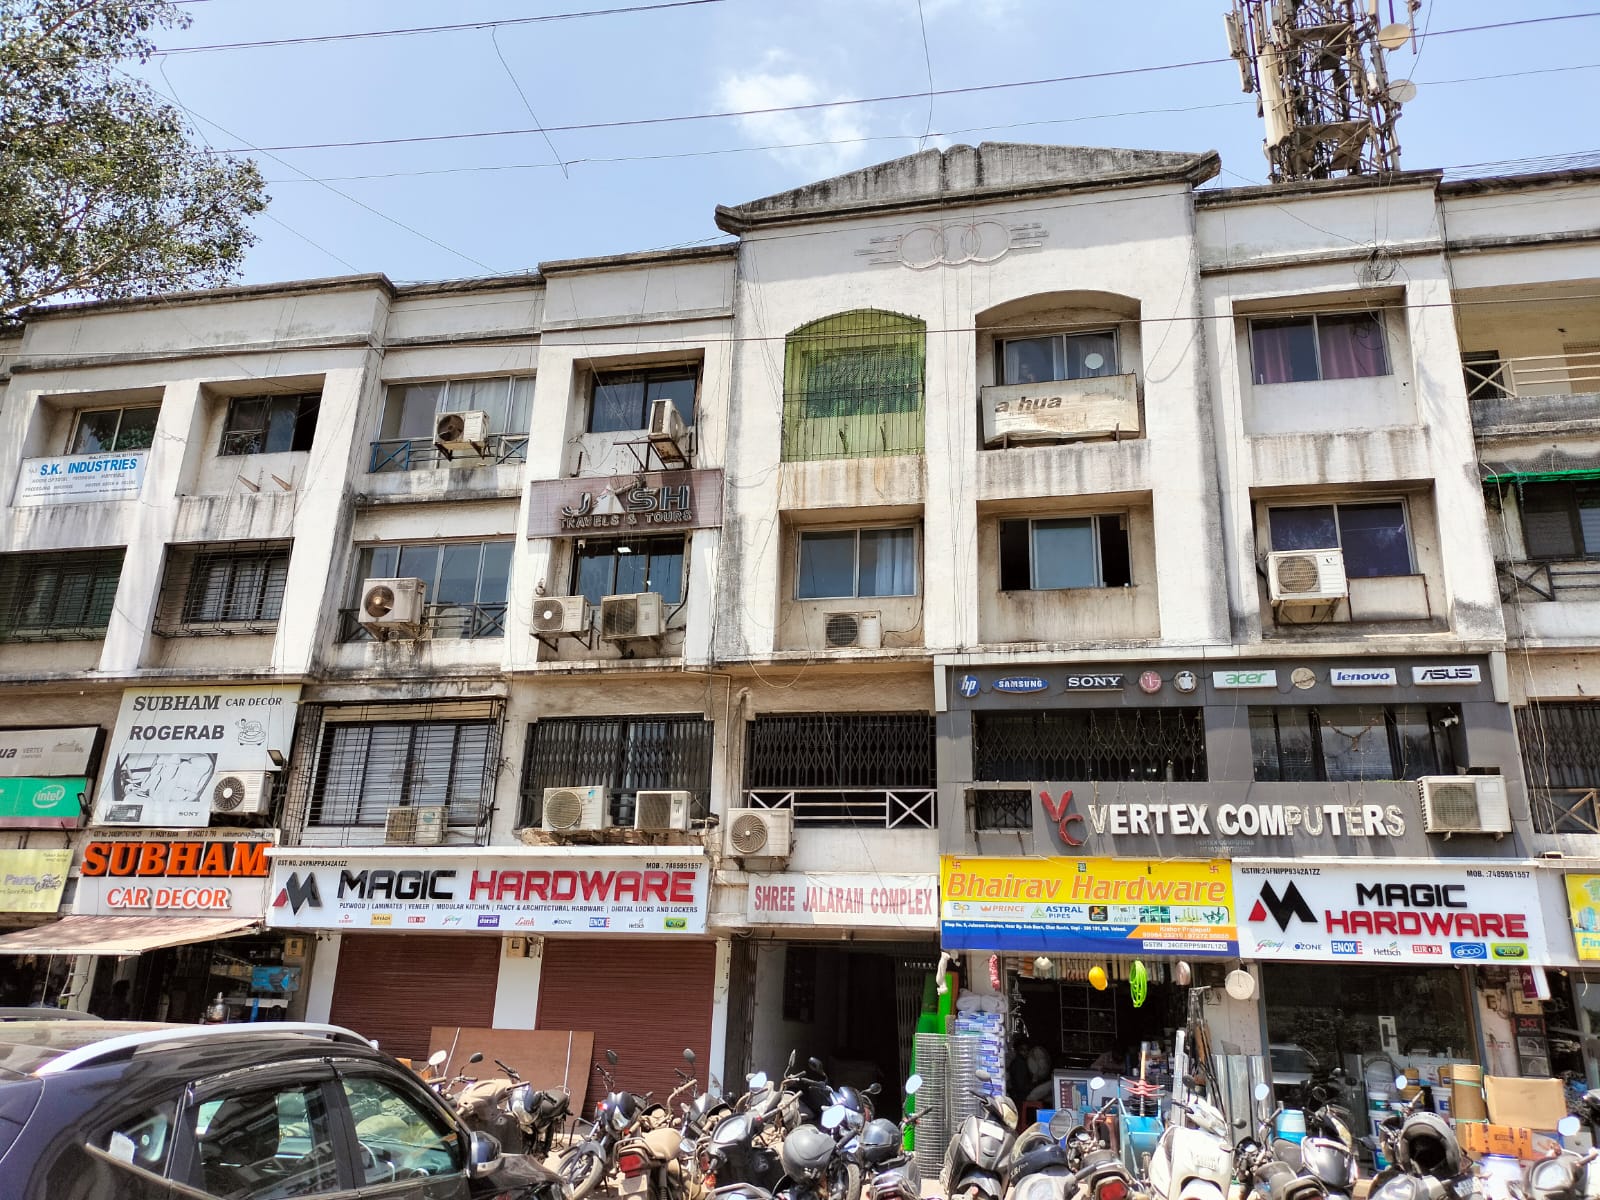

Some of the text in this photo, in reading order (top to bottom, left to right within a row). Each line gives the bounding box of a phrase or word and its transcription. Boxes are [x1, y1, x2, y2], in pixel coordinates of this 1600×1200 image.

[40, 464, 62, 476] S.K.
[68, 458, 137, 474] INDUSTRIES
[559, 510, 692, 530] TRAVELS & TOURS
[998, 679, 1043, 688] SAMSUNG
[1068, 677, 1121, 687] SONY
[1225, 673, 1268, 685] acer
[1336, 671, 1390, 681] lenovo
[1420, 668, 1475, 680] ASUS
[961, 674, 976, 697] hp
[133, 694, 282, 711] SUBHAM CAR DECOR
[129, 725, 225, 741] ROGERAB
[1088, 803, 1405, 837] VERTEX COMPUTERS
[80, 842, 273, 876] SUBHAM
[337, 869, 696, 902] MAGIC HARDWARE
[947, 872, 1226, 902] Bhairav Hardware
[1356, 883, 1467, 908] MAGIC
[107, 888, 229, 908] CAR DECOR
[339, 902, 366, 910] PLYWOOD
[408, 903, 430, 911] VENEER
[436, 903, 464, 911] MODULAR
[522, 904, 570, 912] ARCHITECTURAL
[611, 905, 634, 913] DIGITAL
[635, 905, 655, 913] LOCKS
[754, 885, 932, 914] SHREE JALARAM COMPLEX
[1325, 910, 1528, 939] HARDWARE
